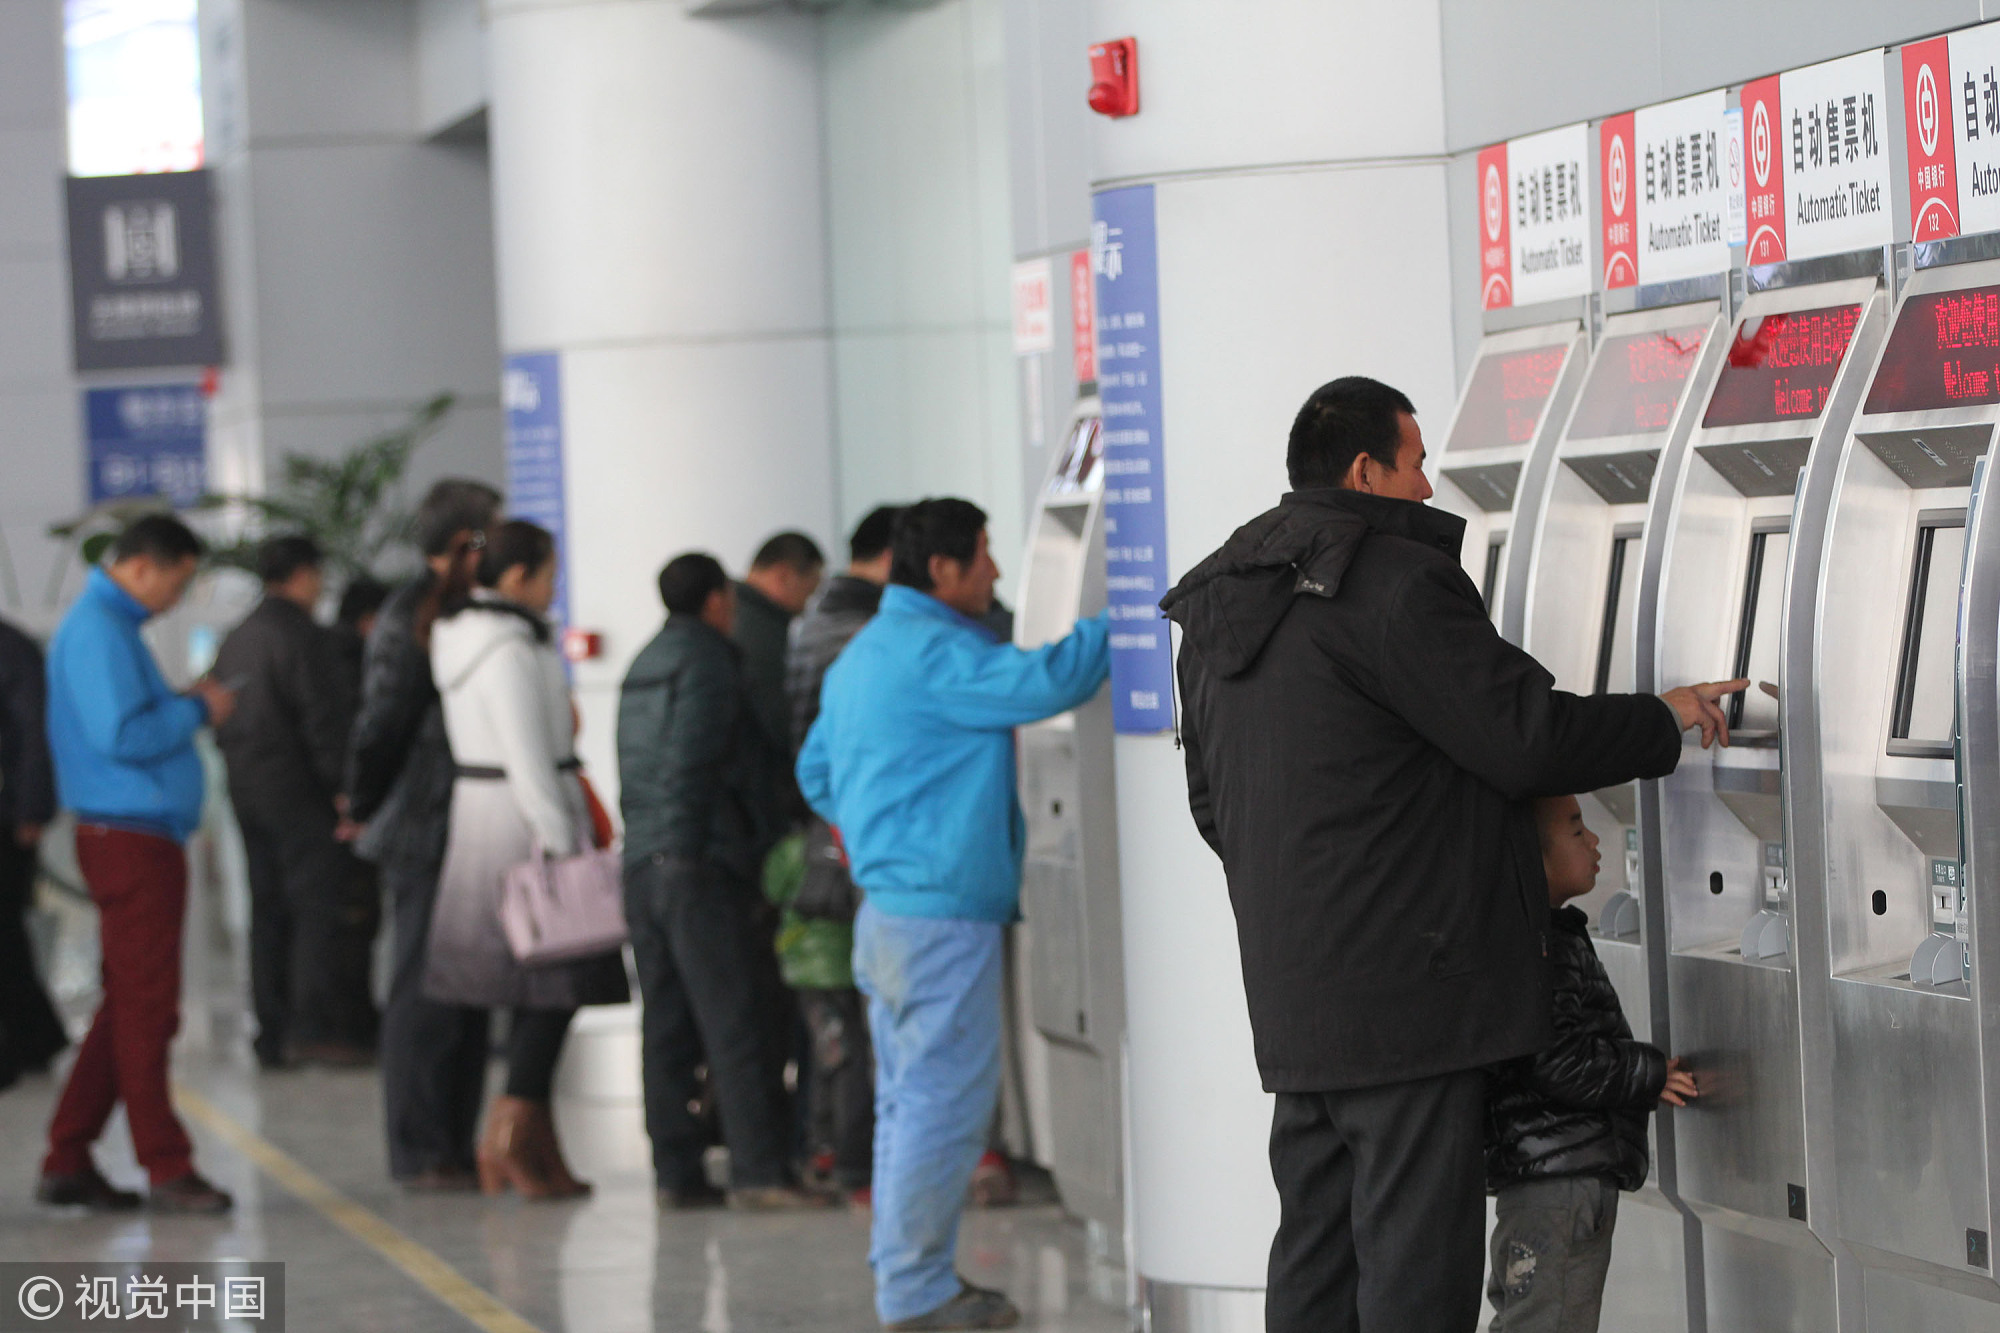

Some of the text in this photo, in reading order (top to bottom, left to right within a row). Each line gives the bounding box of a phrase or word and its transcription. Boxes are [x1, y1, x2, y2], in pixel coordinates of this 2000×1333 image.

[1792, 92, 1878, 174] 自动售票机
[1646, 129, 1720, 203] 自动售票机
[1918, 162, 1945, 192] 中国银行
[1752, 194, 1775, 219] 中国银行
[1797, 180, 1881, 226] Automatic Ticket
[1928, 212, 1940, 232] 132
[1649, 212, 1721, 253] Automatic Ticket
[1759, 239, 1770, 258] 131
[1774, 378, 1813, 416] Welcome
[1943, 360, 1989, 399] Welcome
